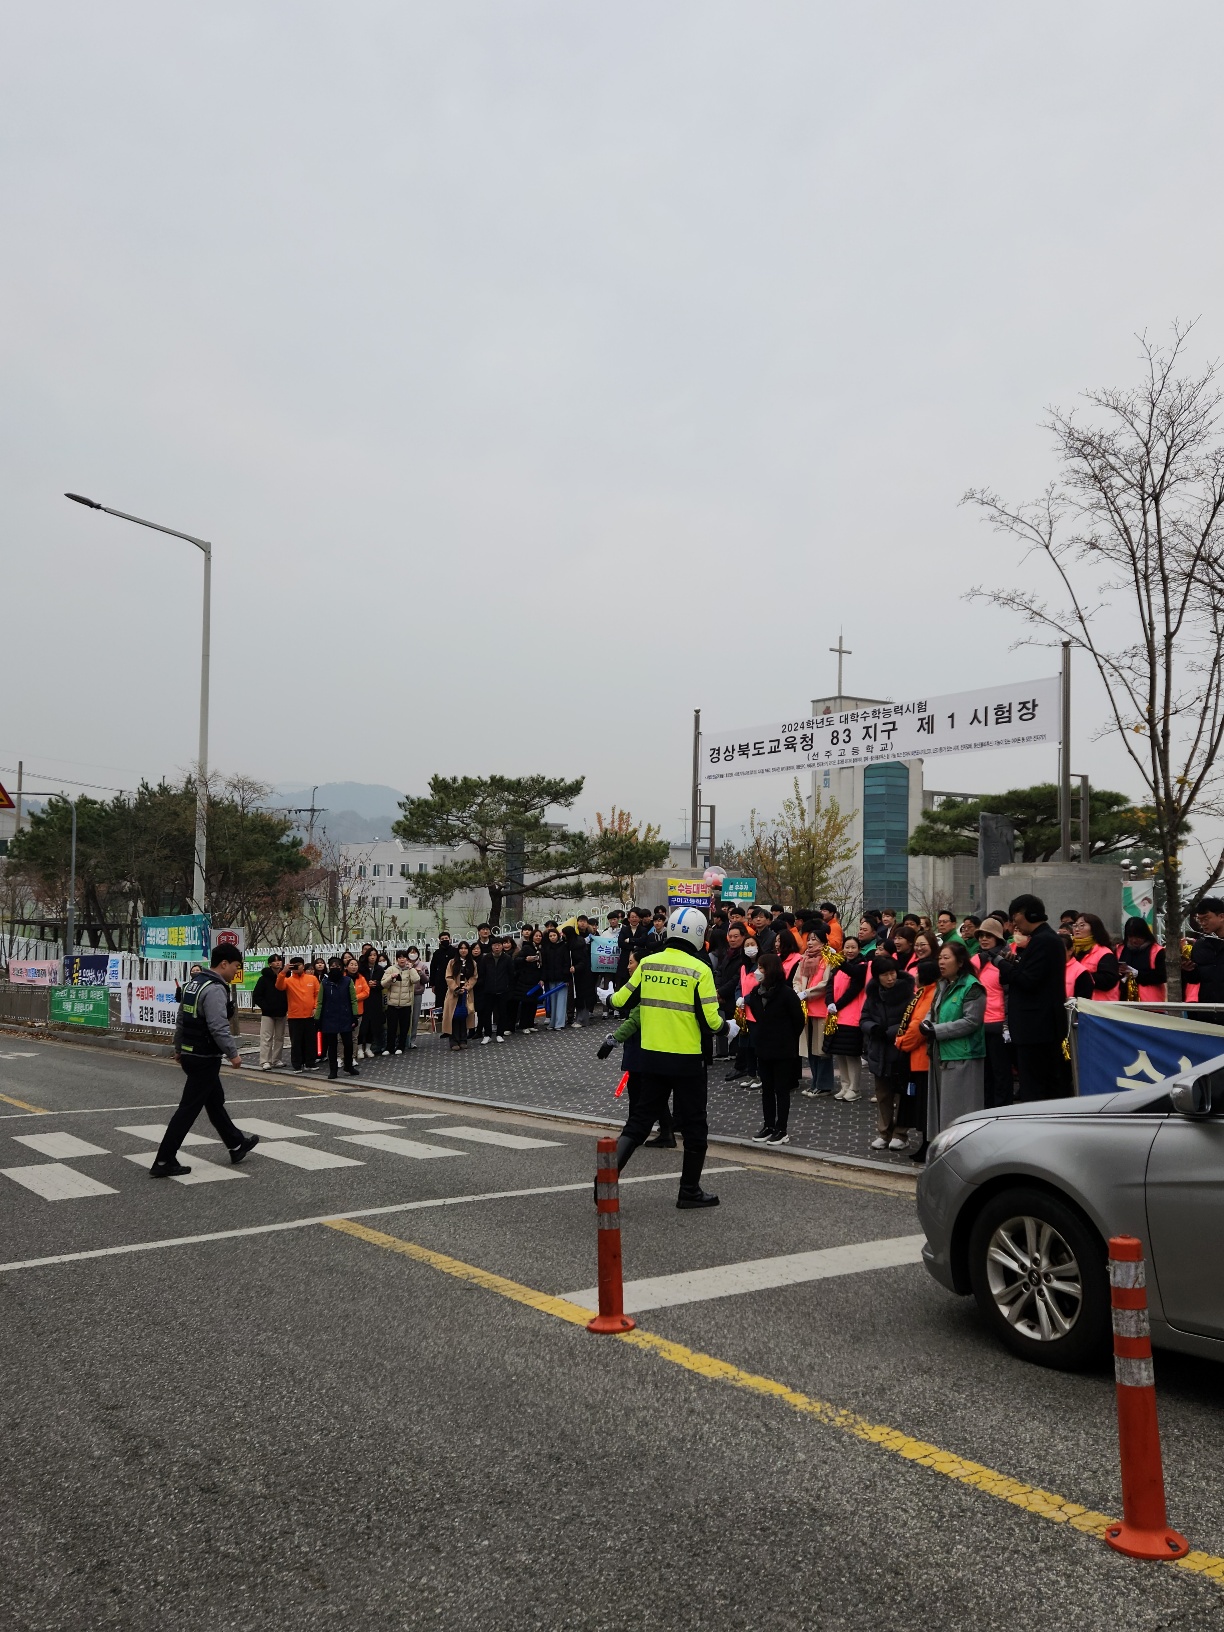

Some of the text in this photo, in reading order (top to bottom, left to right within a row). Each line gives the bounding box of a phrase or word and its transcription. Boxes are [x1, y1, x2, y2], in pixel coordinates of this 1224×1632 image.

[781, 700, 928, 734] 2024학년도 대학수학능력시험
[709, 733, 814, 764] 경상북도교육청
[830, 728, 852, 746] 83
[862, 721, 898, 743] 지구
[917, 714, 935, 735] 제
[947, 712, 956, 730] 1
[969, 698, 1039, 726] 시험장
[671, 897, 709, 906] 구미고등학교
[644, 974, 689, 988] POLICE
